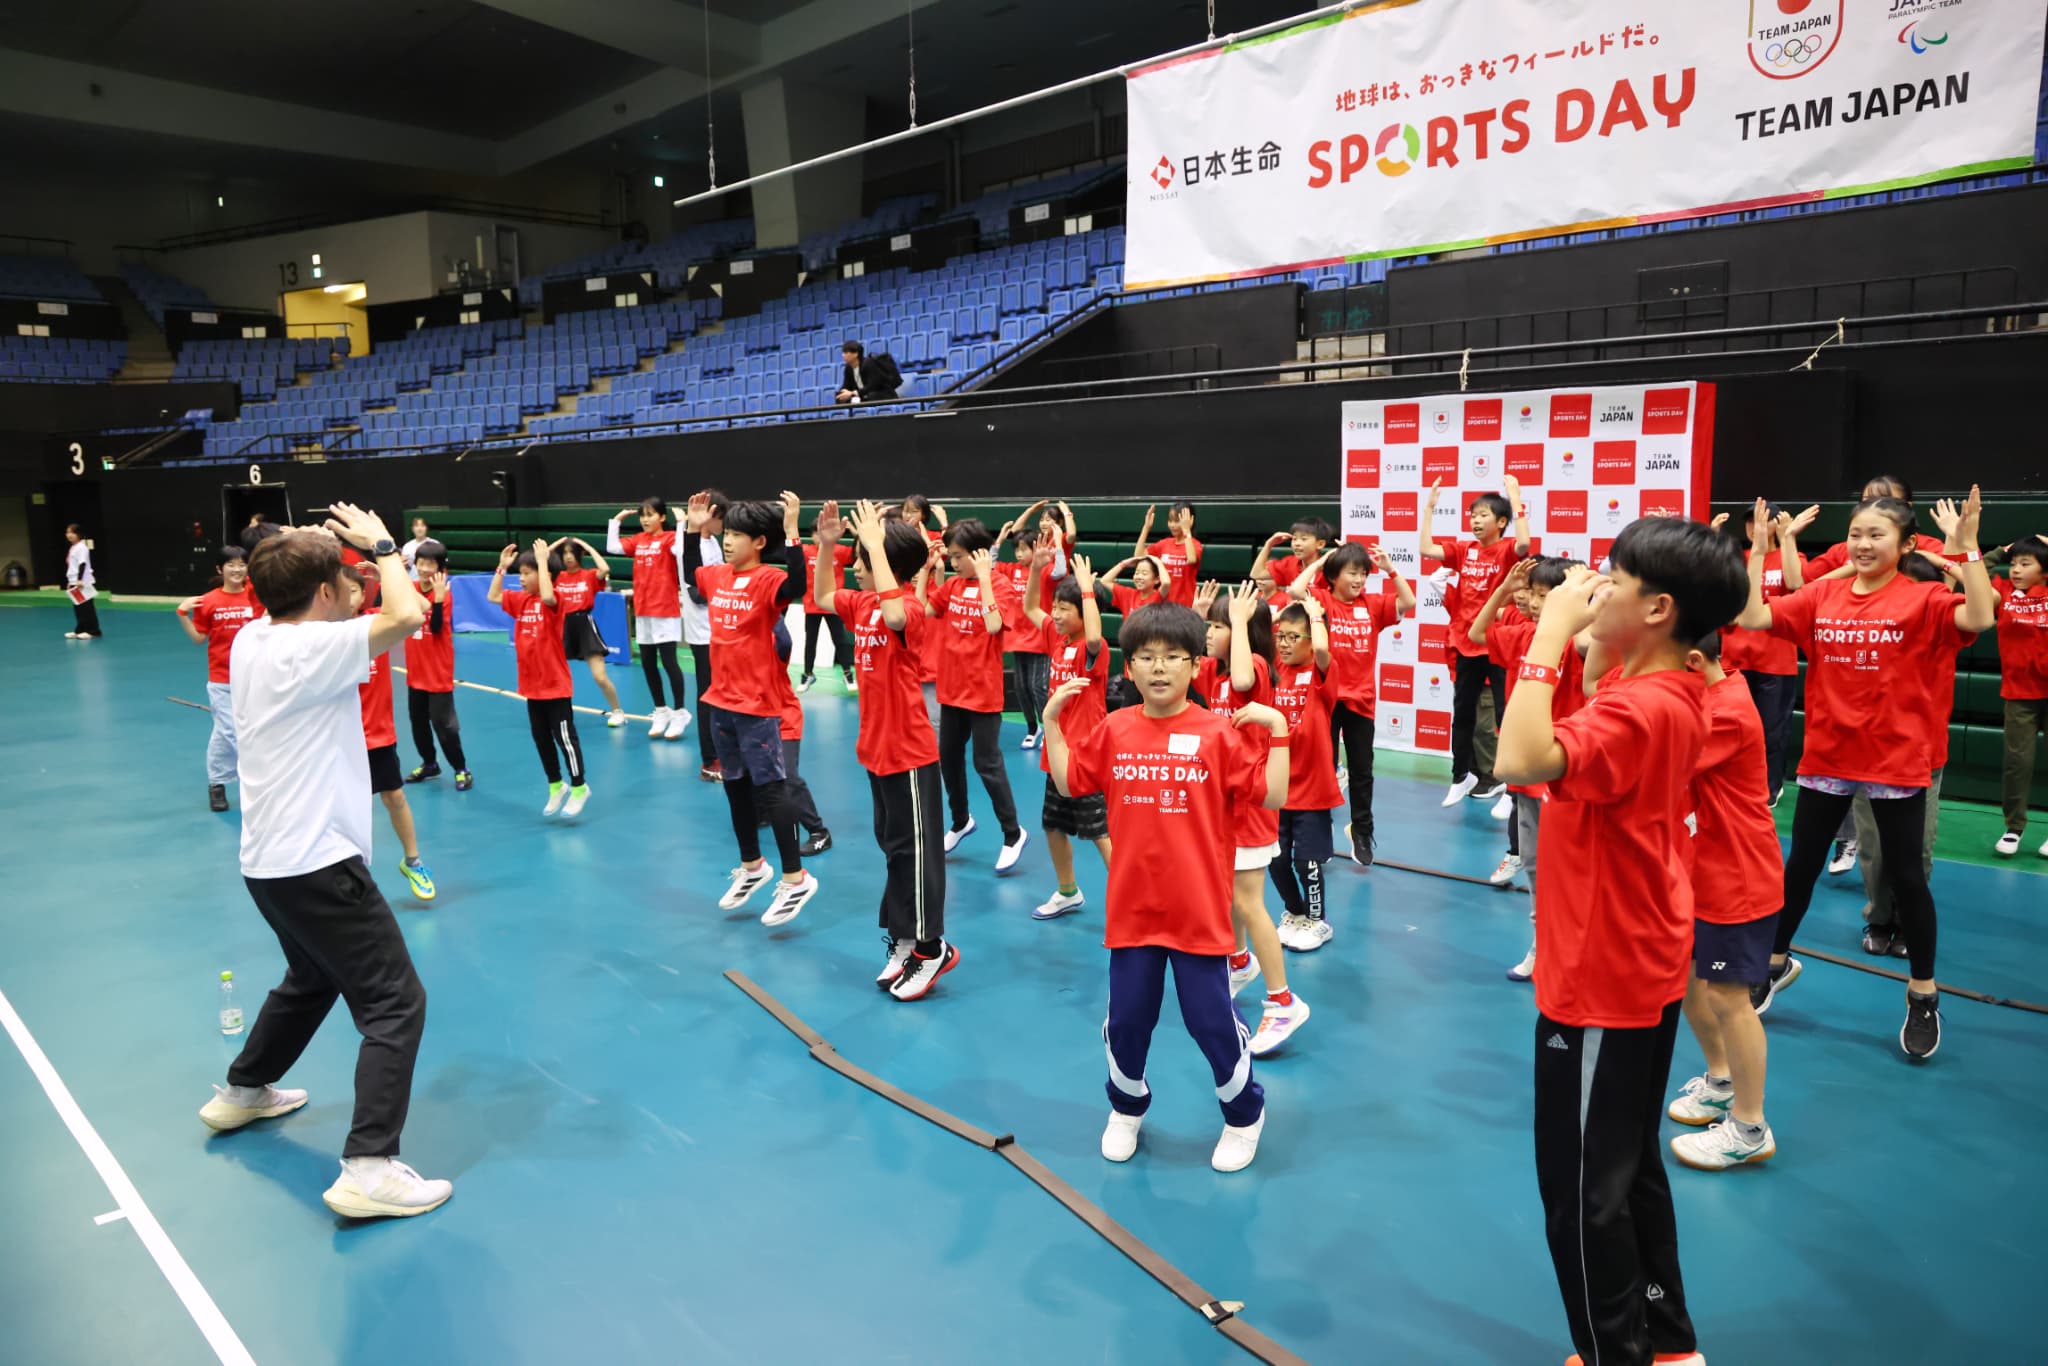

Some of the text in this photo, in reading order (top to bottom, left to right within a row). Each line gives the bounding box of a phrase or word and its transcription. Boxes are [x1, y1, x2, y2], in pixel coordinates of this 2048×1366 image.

[1758, 14, 1832, 41] TEAM JAPAN
[1335, 23, 1659, 113] 地球は、おっきなフィールドだ。
[1735, 71, 1970, 142] TEAM JAPAN
[1307, 67, 1697, 189] SPORTS DAY
[1183, 140, 1282, 186] 日本生命
[278, 261, 298, 288] 13
[1600, 411, 1634, 422] JAPAN
[69, 442, 85, 476] 3
[1645, 459, 1680, 470] JAPAN
[249, 464, 262, 485] 6
[1349, 510, 1376, 518] JAPAN
[1423, 598, 1444, 607] JAP
[1868, 629, 1904, 643] DAY
[1522, 665, 1546, 678] 1-D
[1112, 764, 1209, 784] SPORTS DAY
[1308, 883, 1321, 921] NDER
